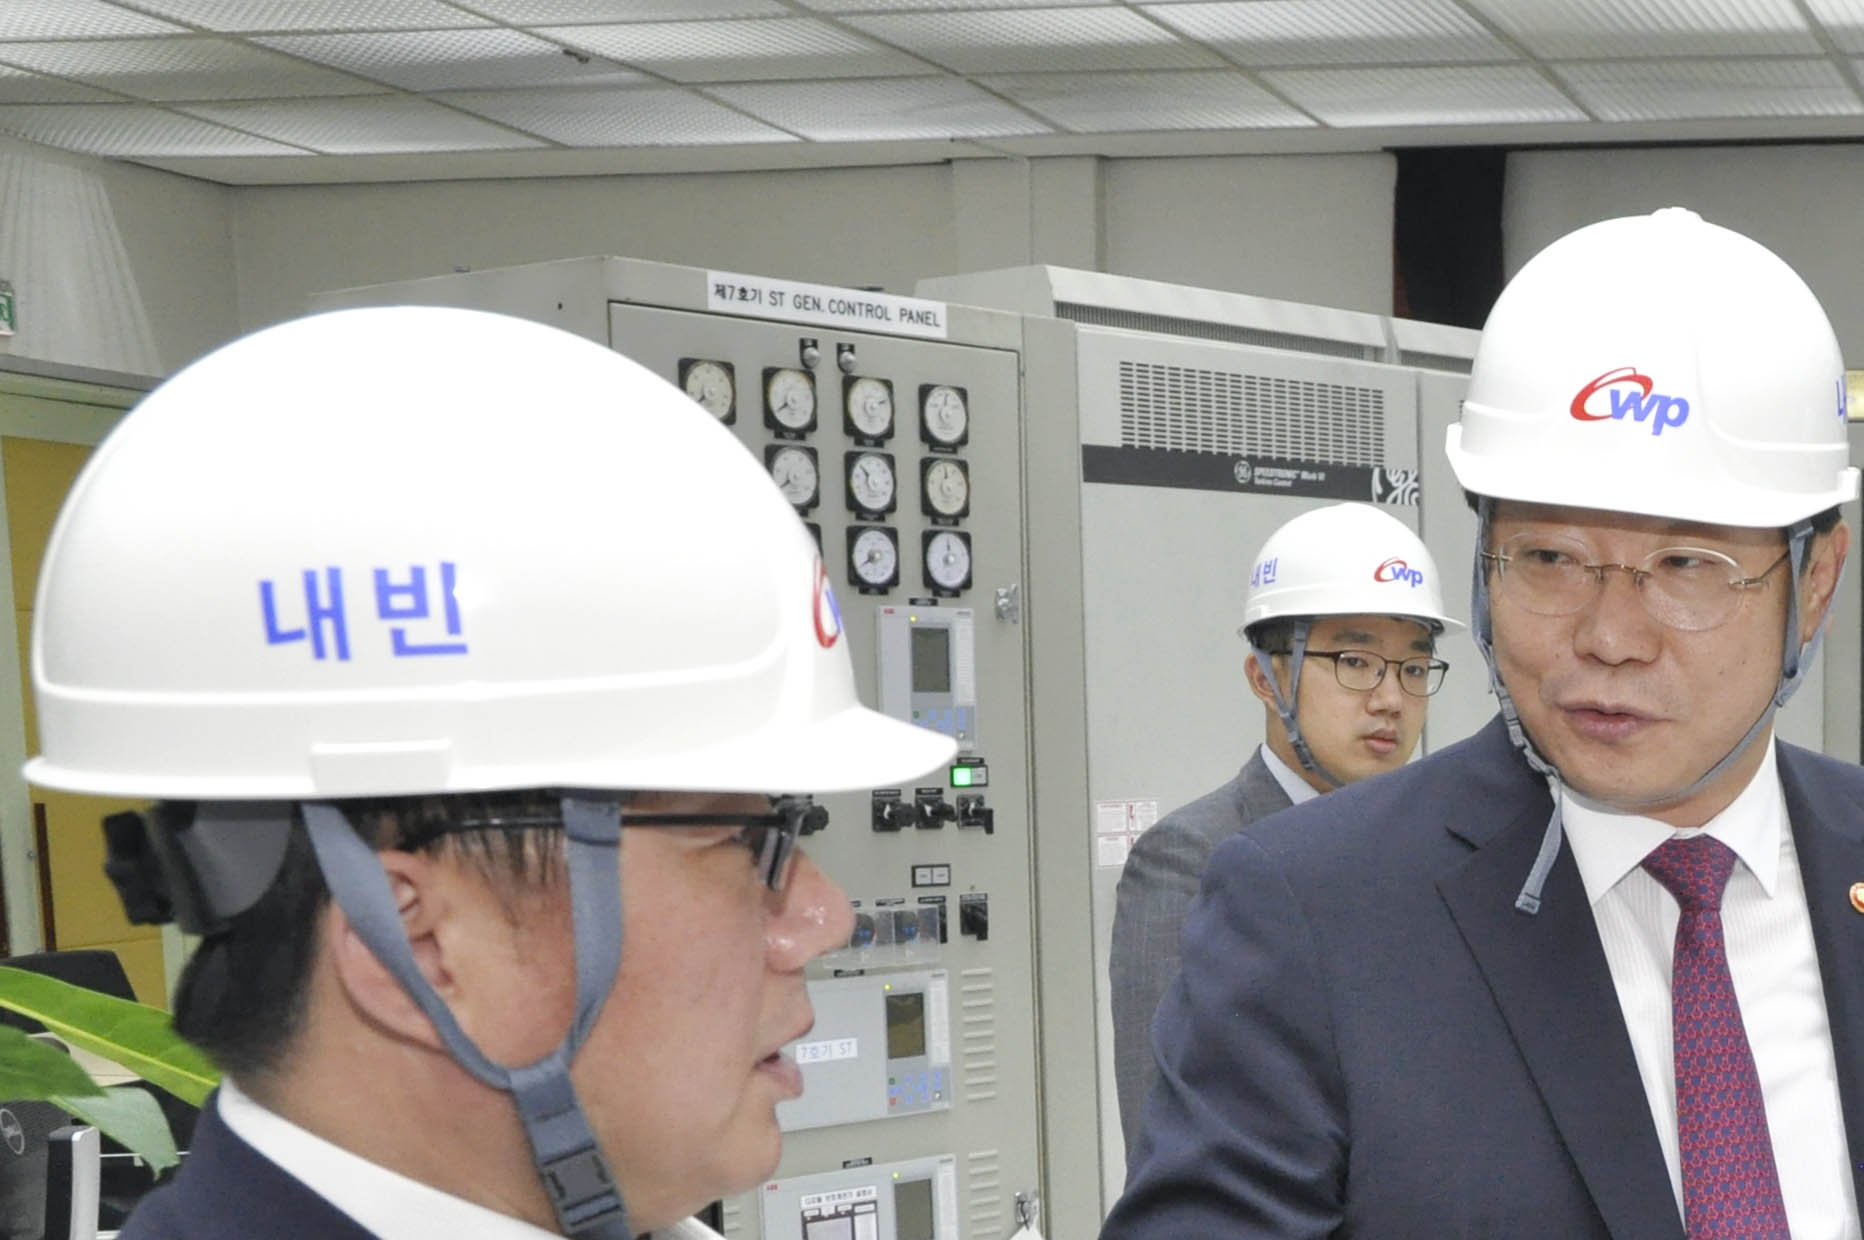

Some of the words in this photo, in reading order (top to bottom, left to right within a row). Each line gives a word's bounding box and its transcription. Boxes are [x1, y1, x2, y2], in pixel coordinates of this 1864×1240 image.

[714, 283, 762, 304] 제7호기
[769, 291, 785, 306] ST
[829, 299, 892, 321] CONTROL
[900, 308, 940, 327] PANEL
[259, 560, 468, 661] 내빈
